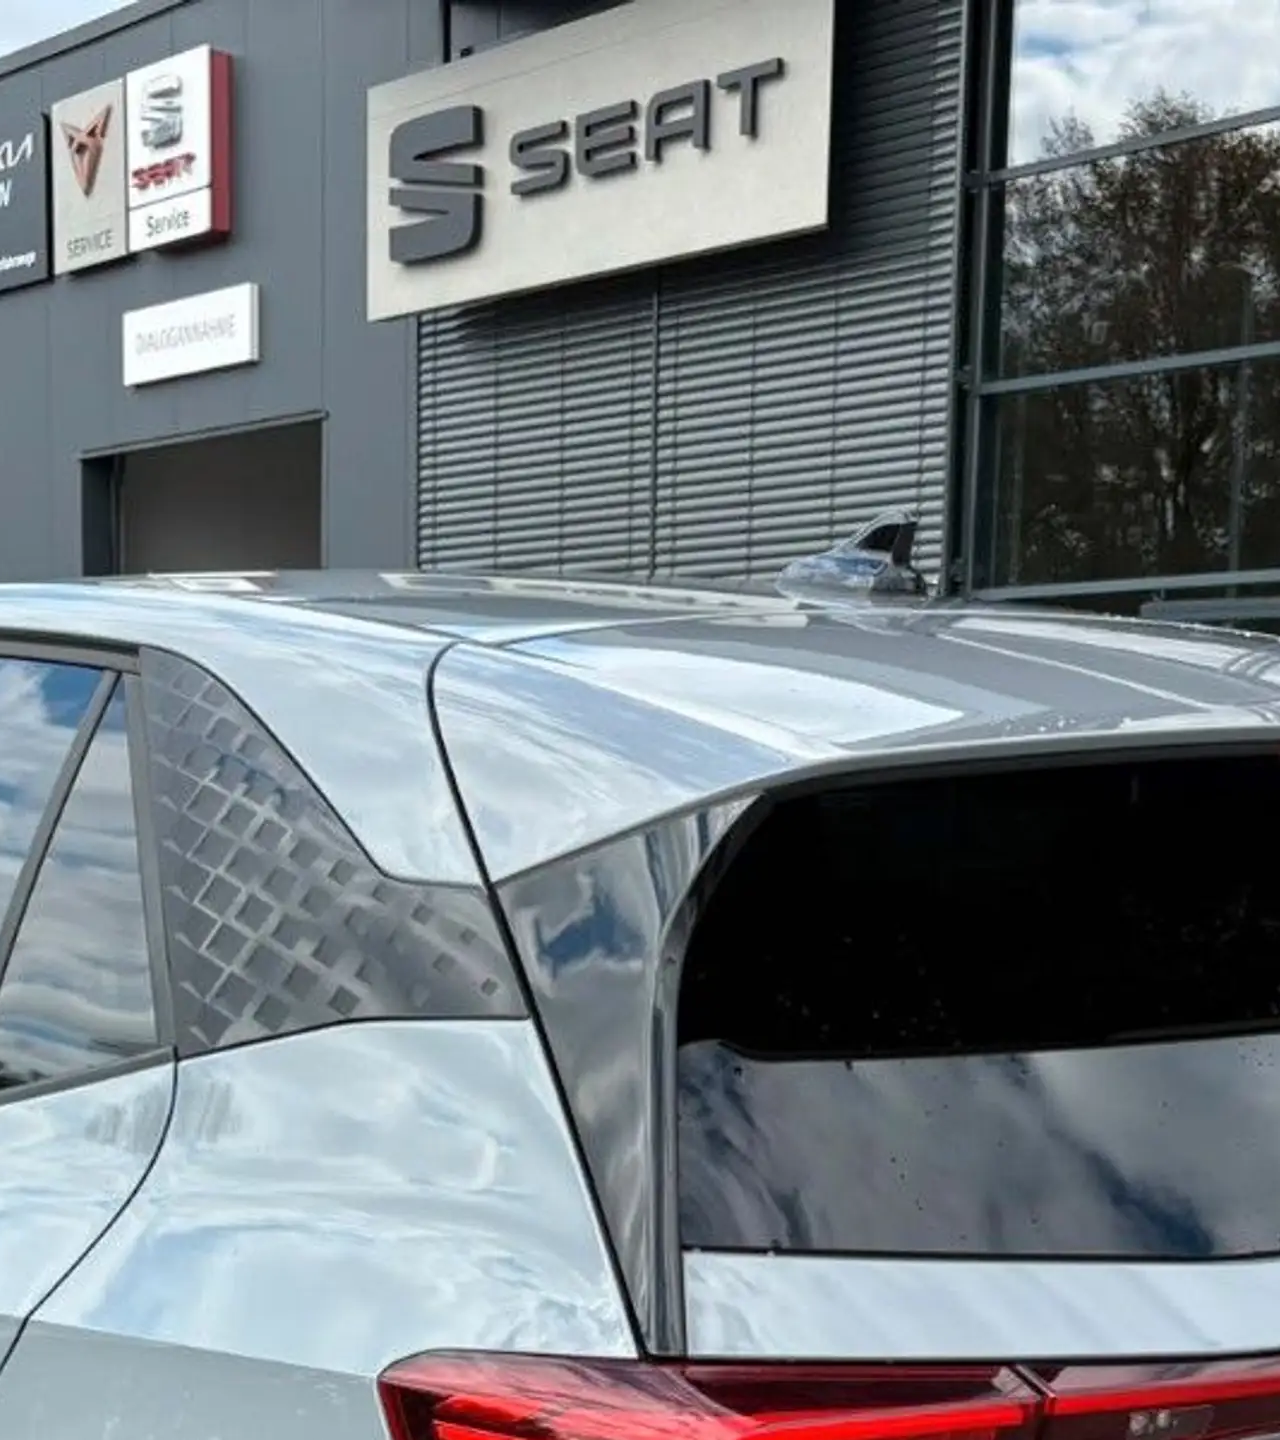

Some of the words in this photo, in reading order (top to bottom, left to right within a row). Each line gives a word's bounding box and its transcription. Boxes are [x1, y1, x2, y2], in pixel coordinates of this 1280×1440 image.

[509, 57, 784, 197] SEAT
[132, 152, 197, 190] SEAT
[146, 209, 190, 238] Service
[67, 228, 113, 258] SERVICE
